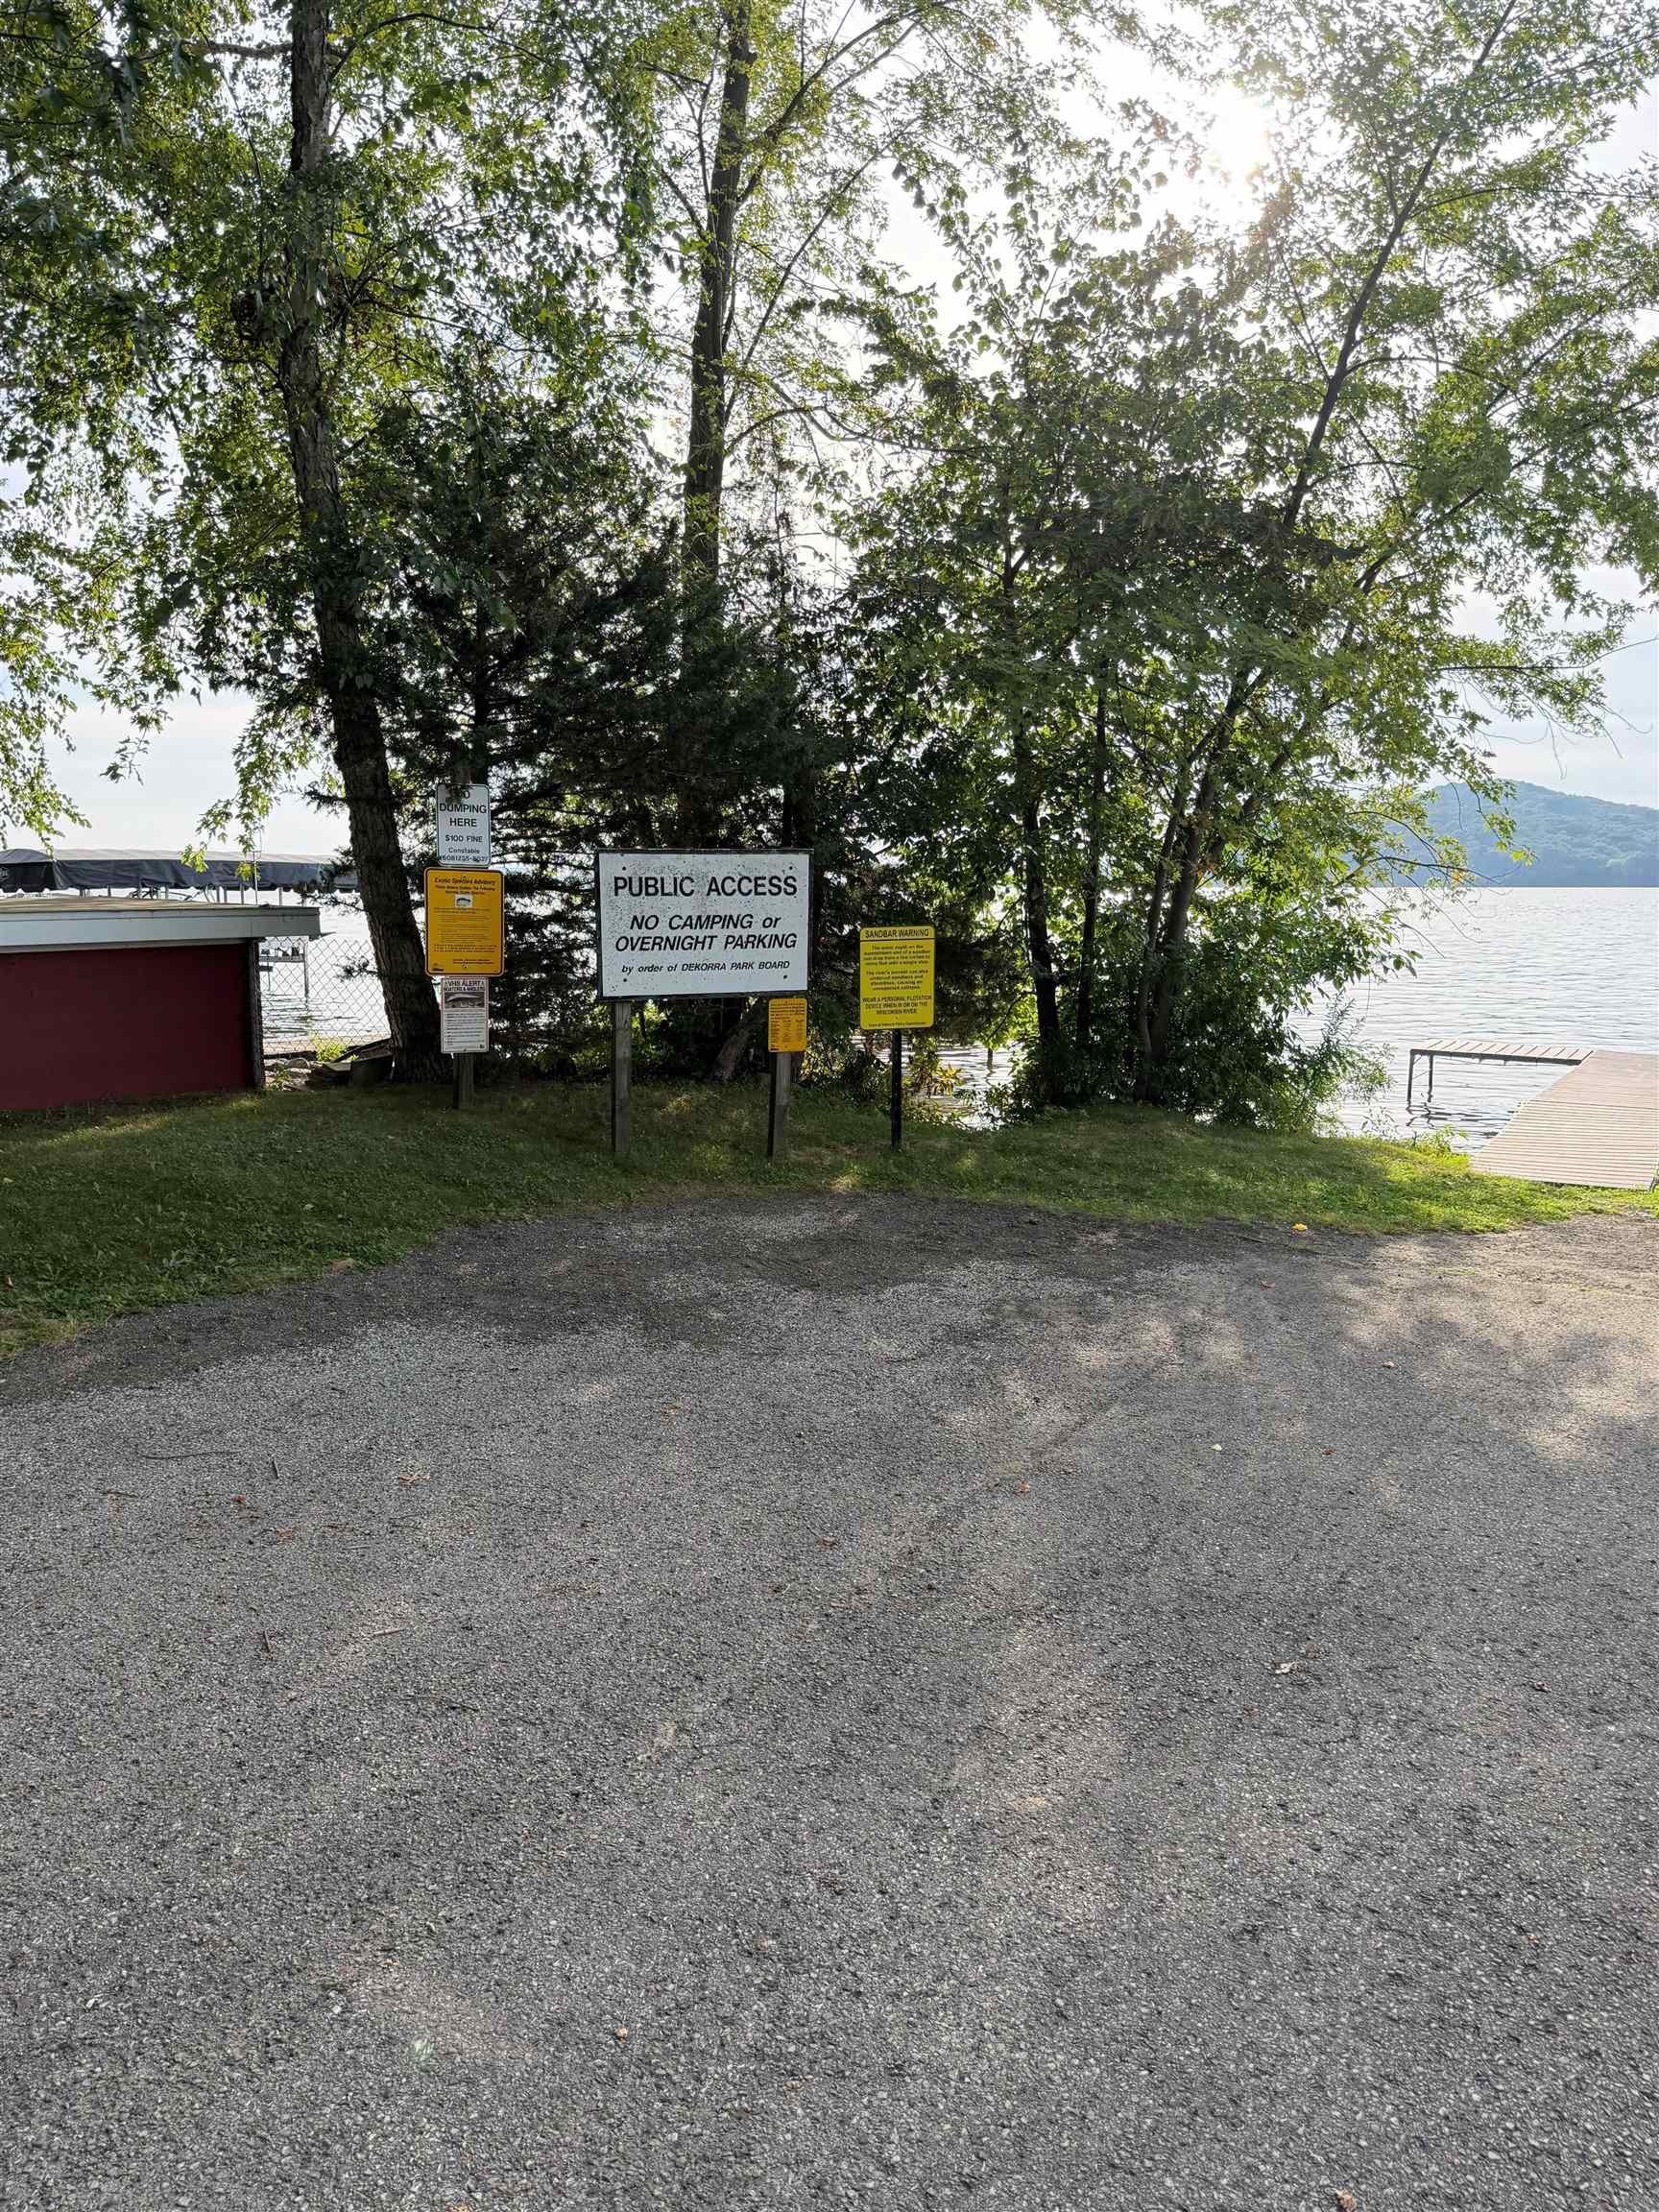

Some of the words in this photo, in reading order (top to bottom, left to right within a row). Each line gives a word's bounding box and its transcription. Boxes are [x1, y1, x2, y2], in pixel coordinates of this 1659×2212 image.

[439, 803, 487, 814] DUMPING
[449, 817, 477, 828] HERE
[445, 833, 465, 843] $100
[466, 834, 484, 843] FINE
[447, 846, 481, 854] Constable
[613, 876, 695, 898] PUBLIC
[706, 875, 798, 897] ACCESS
[630, 914, 660, 930] NO
[668, 913, 754, 930] CAMPING
[761, 916, 781, 929] or
[865, 929, 897, 939] SANDBAR
[898, 928, 929, 938] WARNING
[615, 935, 718, 951] OVERNIGHT
[724, 932, 798, 950] PARKING
[621, 964, 634, 975] by
[637, 964, 662, 973] order
[667, 963, 678, 972] of
[681, 962, 726, 972] DEKORRA
[730, 961, 755, 971] PARK
[758, 960, 790, 970] BOARD
